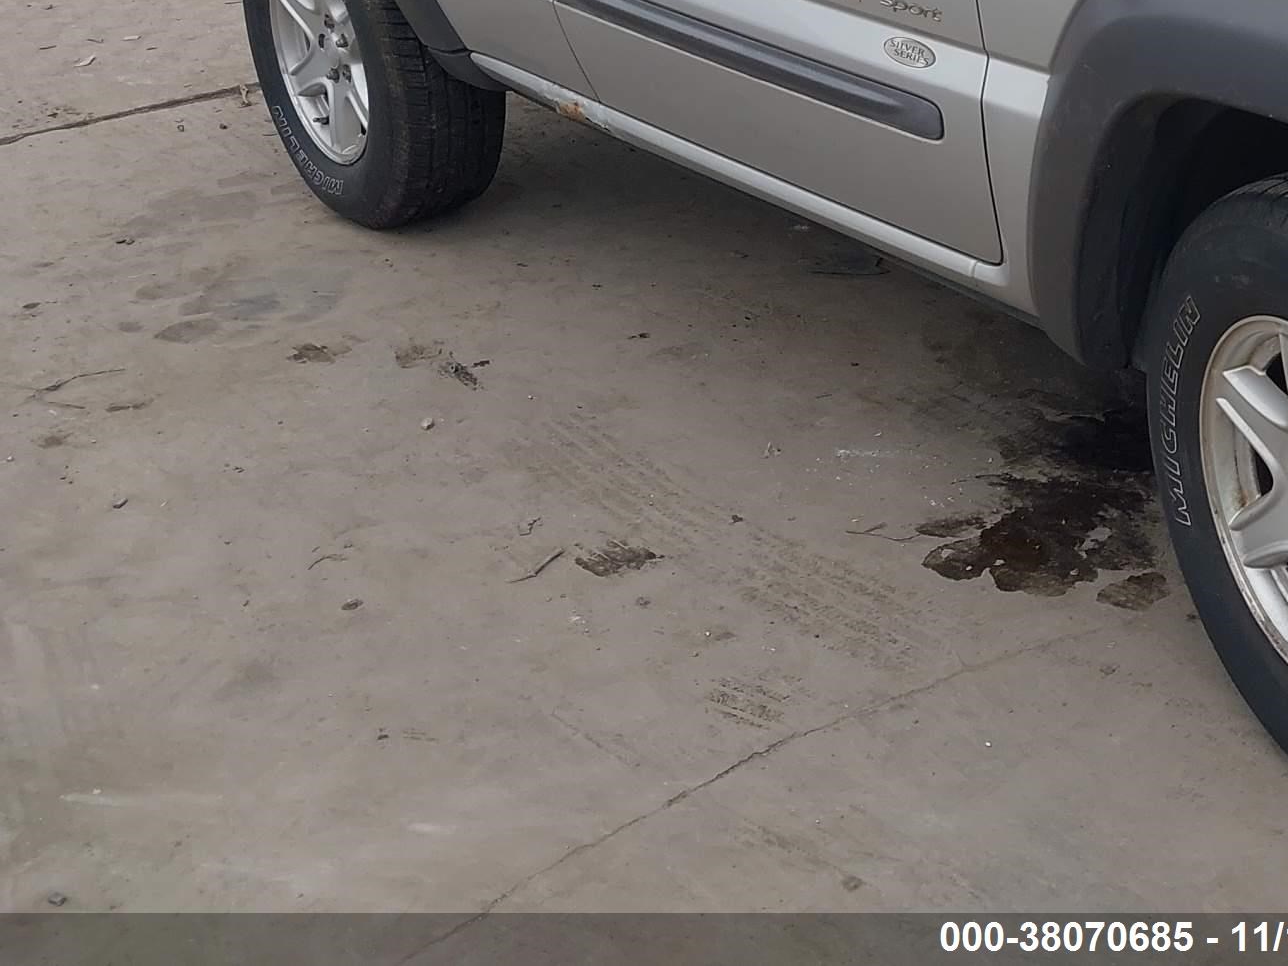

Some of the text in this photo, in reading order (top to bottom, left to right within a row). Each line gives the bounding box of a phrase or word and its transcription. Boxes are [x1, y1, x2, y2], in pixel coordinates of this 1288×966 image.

[889, 38, 928, 57] SILVER
[892, 47, 930, 66] SERIES
[1157, 294, 1202, 528] MICHELIN
